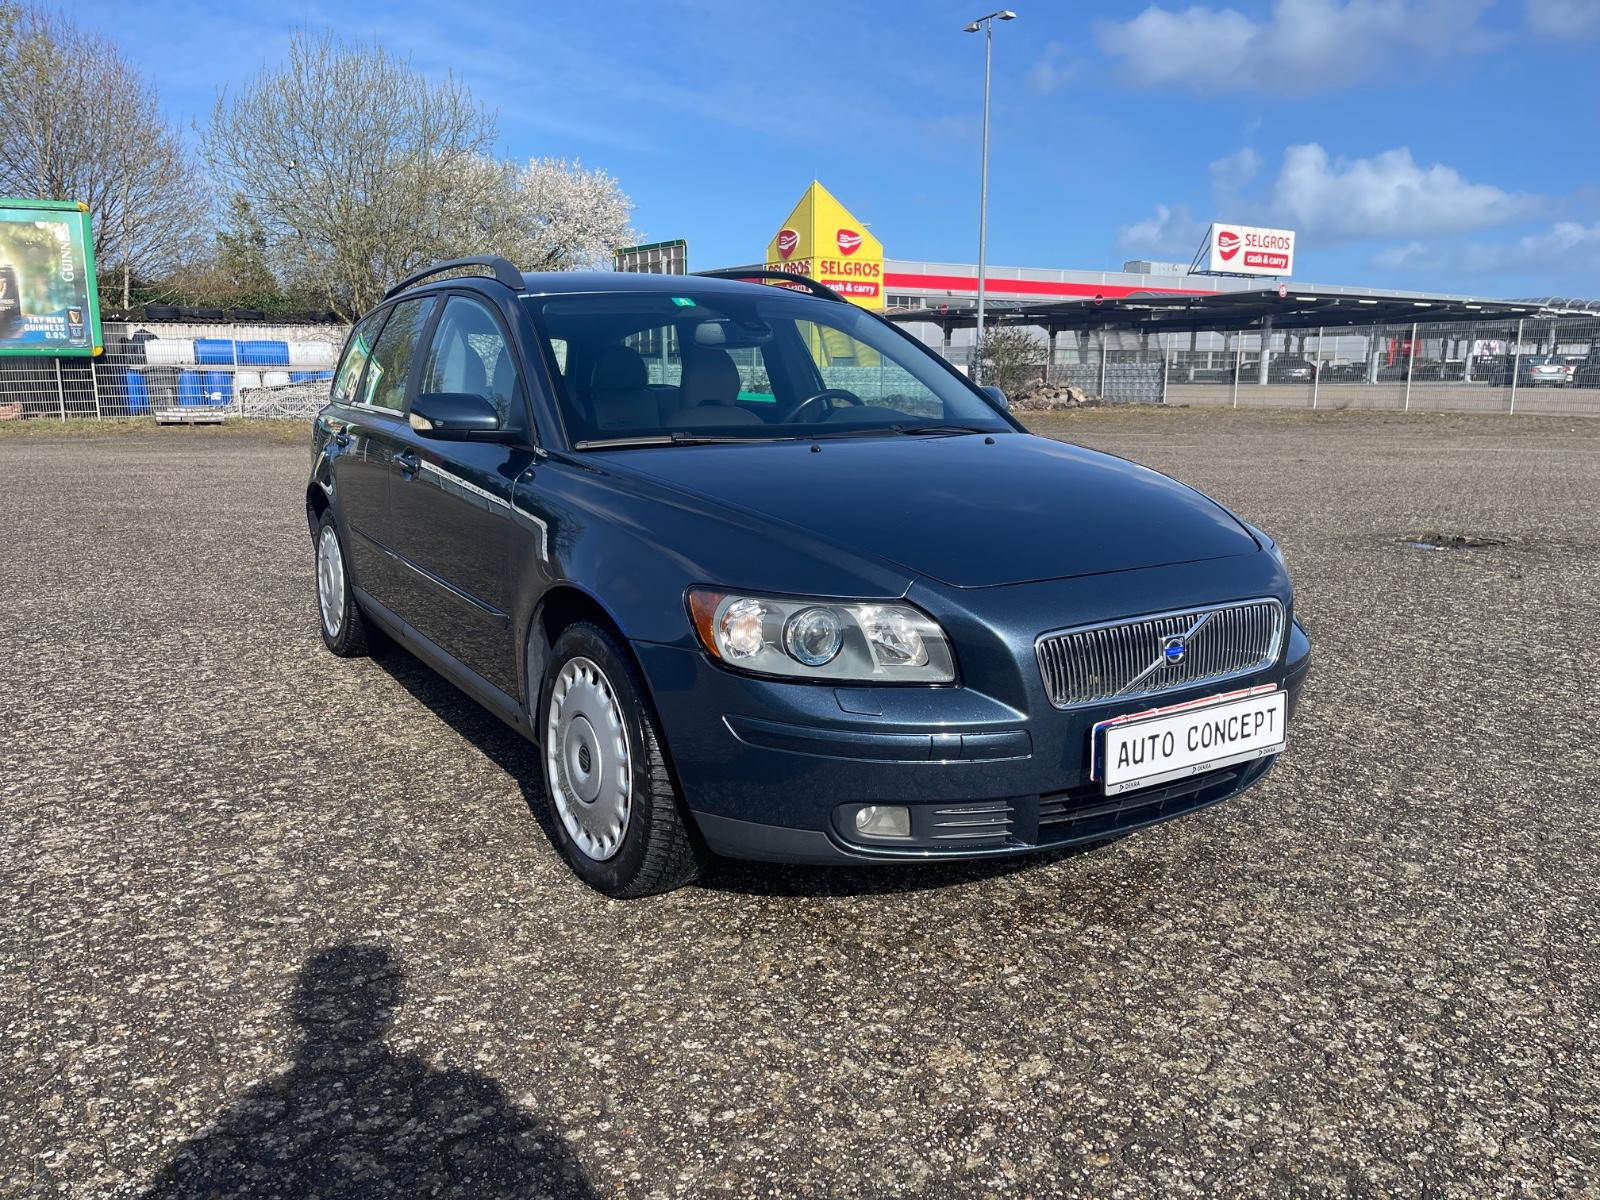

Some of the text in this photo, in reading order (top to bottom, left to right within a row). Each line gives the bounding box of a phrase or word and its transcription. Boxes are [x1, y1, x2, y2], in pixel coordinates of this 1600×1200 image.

[1245, 234, 1290, 250] SELGROS
[1247, 254, 1287, 267] cash & carry
[821, 260, 880, 277] SELGROS
[846, 283, 853, 292] &
[854, 286, 875, 295] carry
[25, 324, 65, 332] GUINNESS
[45, 331, 66, 339] 0.0%
[1117, 707, 1277, 768] AUTO CONCEPT
